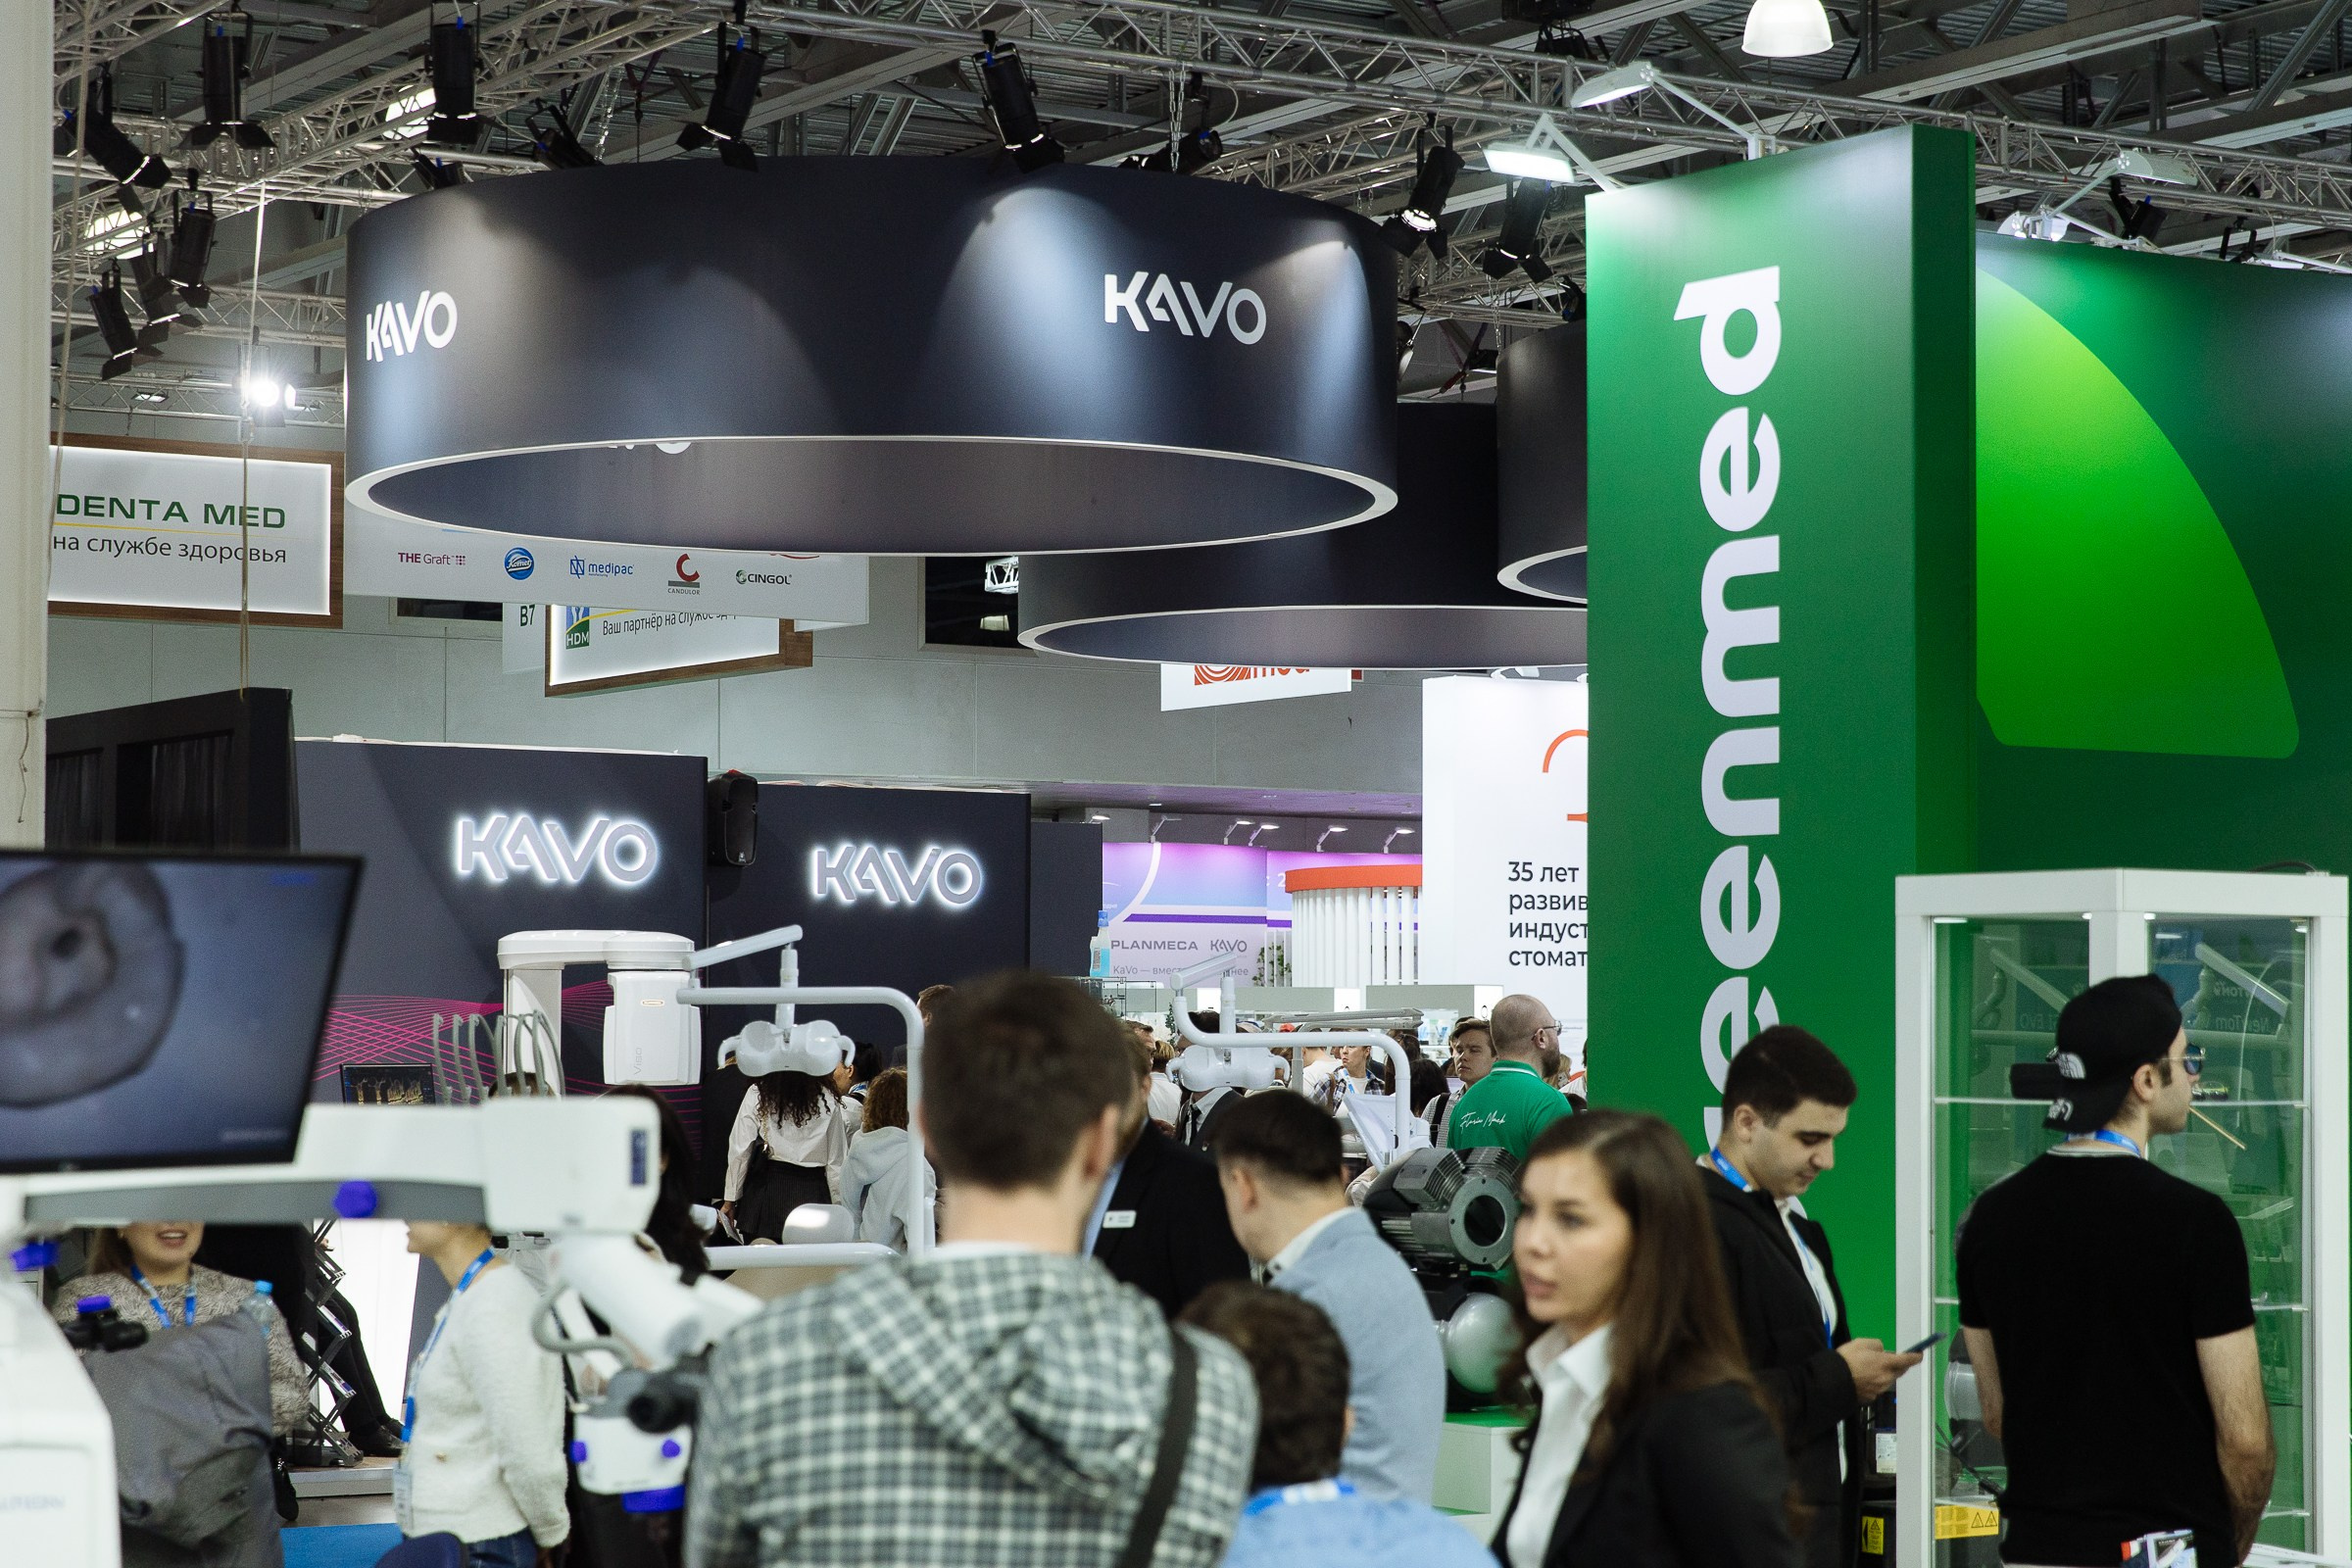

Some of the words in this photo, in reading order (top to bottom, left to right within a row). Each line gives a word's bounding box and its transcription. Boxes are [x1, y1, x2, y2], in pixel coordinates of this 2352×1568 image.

[1103, 271, 1267, 346] KAVO
[366, 290, 458, 363] KAVO
[56, 493, 190, 523] DENTA
[203, 503, 286, 529] MED
[53, 535, 80, 551] на
[86, 536, 172, 559] службе
[178, 542, 287, 564] здоровья
[397, 552, 421, 564] THE
[423, 554, 451, 565] Graft
[588, 563, 634, 576] medipac
[747, 573, 791, 585] CINGOL
[667, 587, 701, 596] CANDULOR
[519, 604, 536, 627] B7
[603, 619, 621, 636] Ваш
[623, 612, 662, 635] партнёр
[664, 612, 676, 626] на
[565, 632, 589, 647] HDM
[461, 814, 658, 883] KAVO
[816, 845, 982, 905] KAVO
[1508, 860, 1534, 883] 35
[1540, 865, 1580, 883] лет
[1110, 940, 1199, 951] PLANMECA
[1210, 938, 1248, 953] KAVO
[1113, 964, 1139, 975] KaVo
